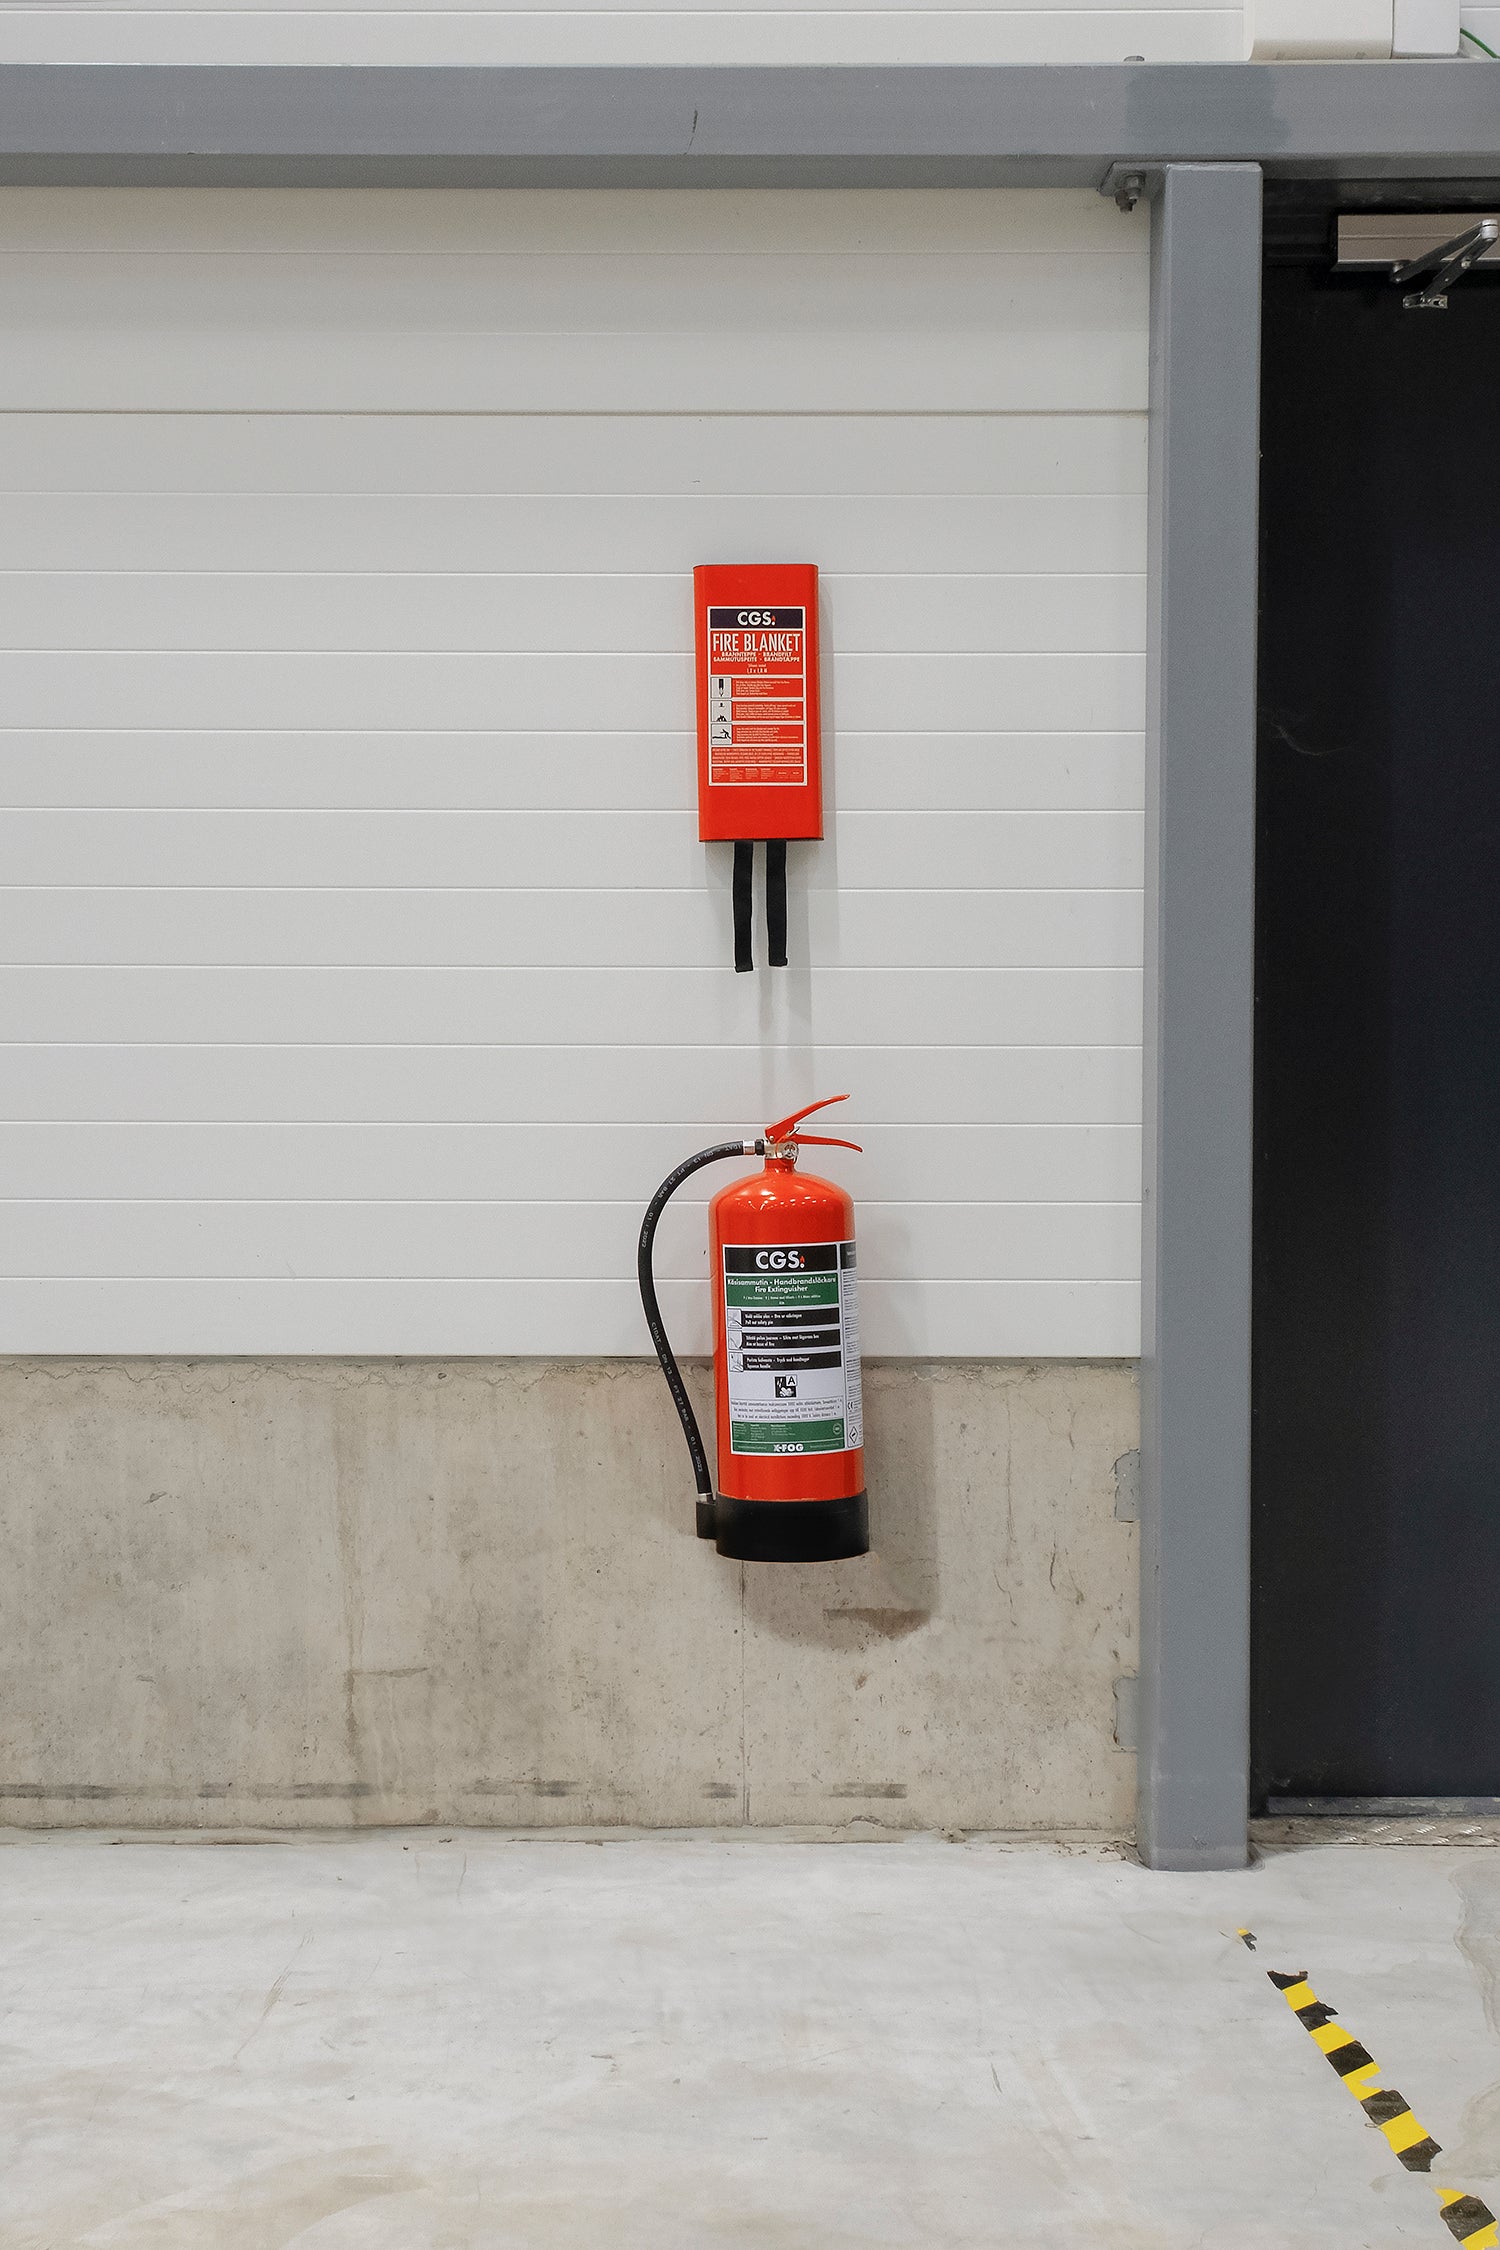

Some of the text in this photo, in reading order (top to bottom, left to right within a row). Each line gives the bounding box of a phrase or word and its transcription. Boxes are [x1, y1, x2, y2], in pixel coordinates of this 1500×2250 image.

[712, 633, 801, 652] FIRE BLANKET
[768, 1285, 808, 1294] Extinguisher
[787, 1376, 796, 1385] A
[773, 1443, 804, 1453] X-FOG
